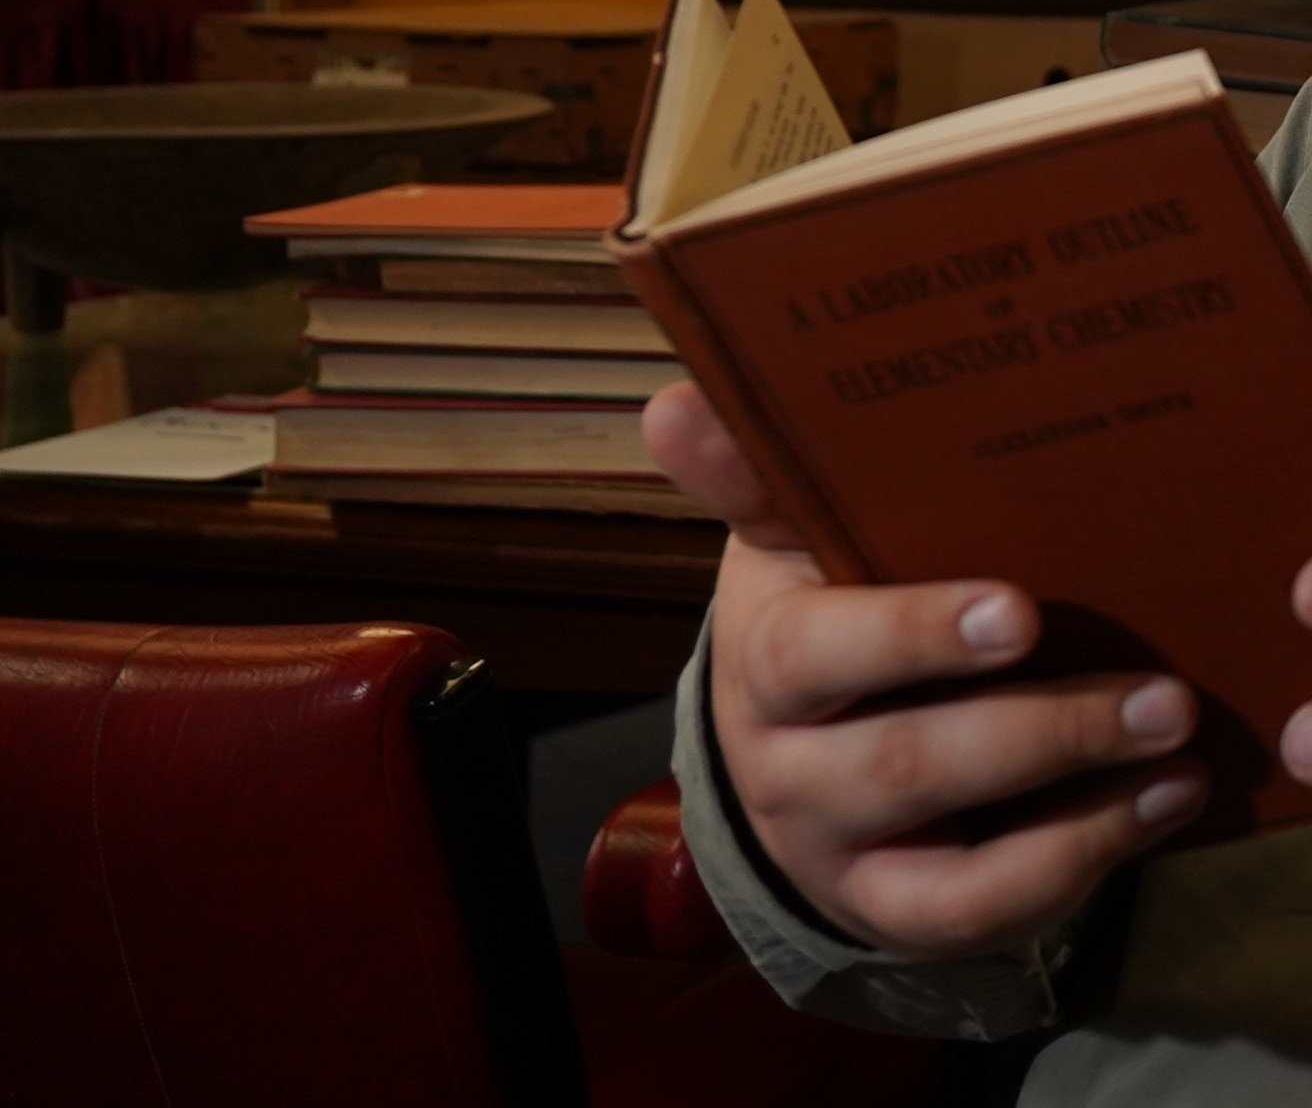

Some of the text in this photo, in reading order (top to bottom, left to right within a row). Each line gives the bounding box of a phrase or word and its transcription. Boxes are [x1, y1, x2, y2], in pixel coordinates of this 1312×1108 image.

[785, 197, 1201, 332] A LABORATORY OUTLINE
[827, 275, 1237, 406] ELEMENTARY CHEMISTRY
